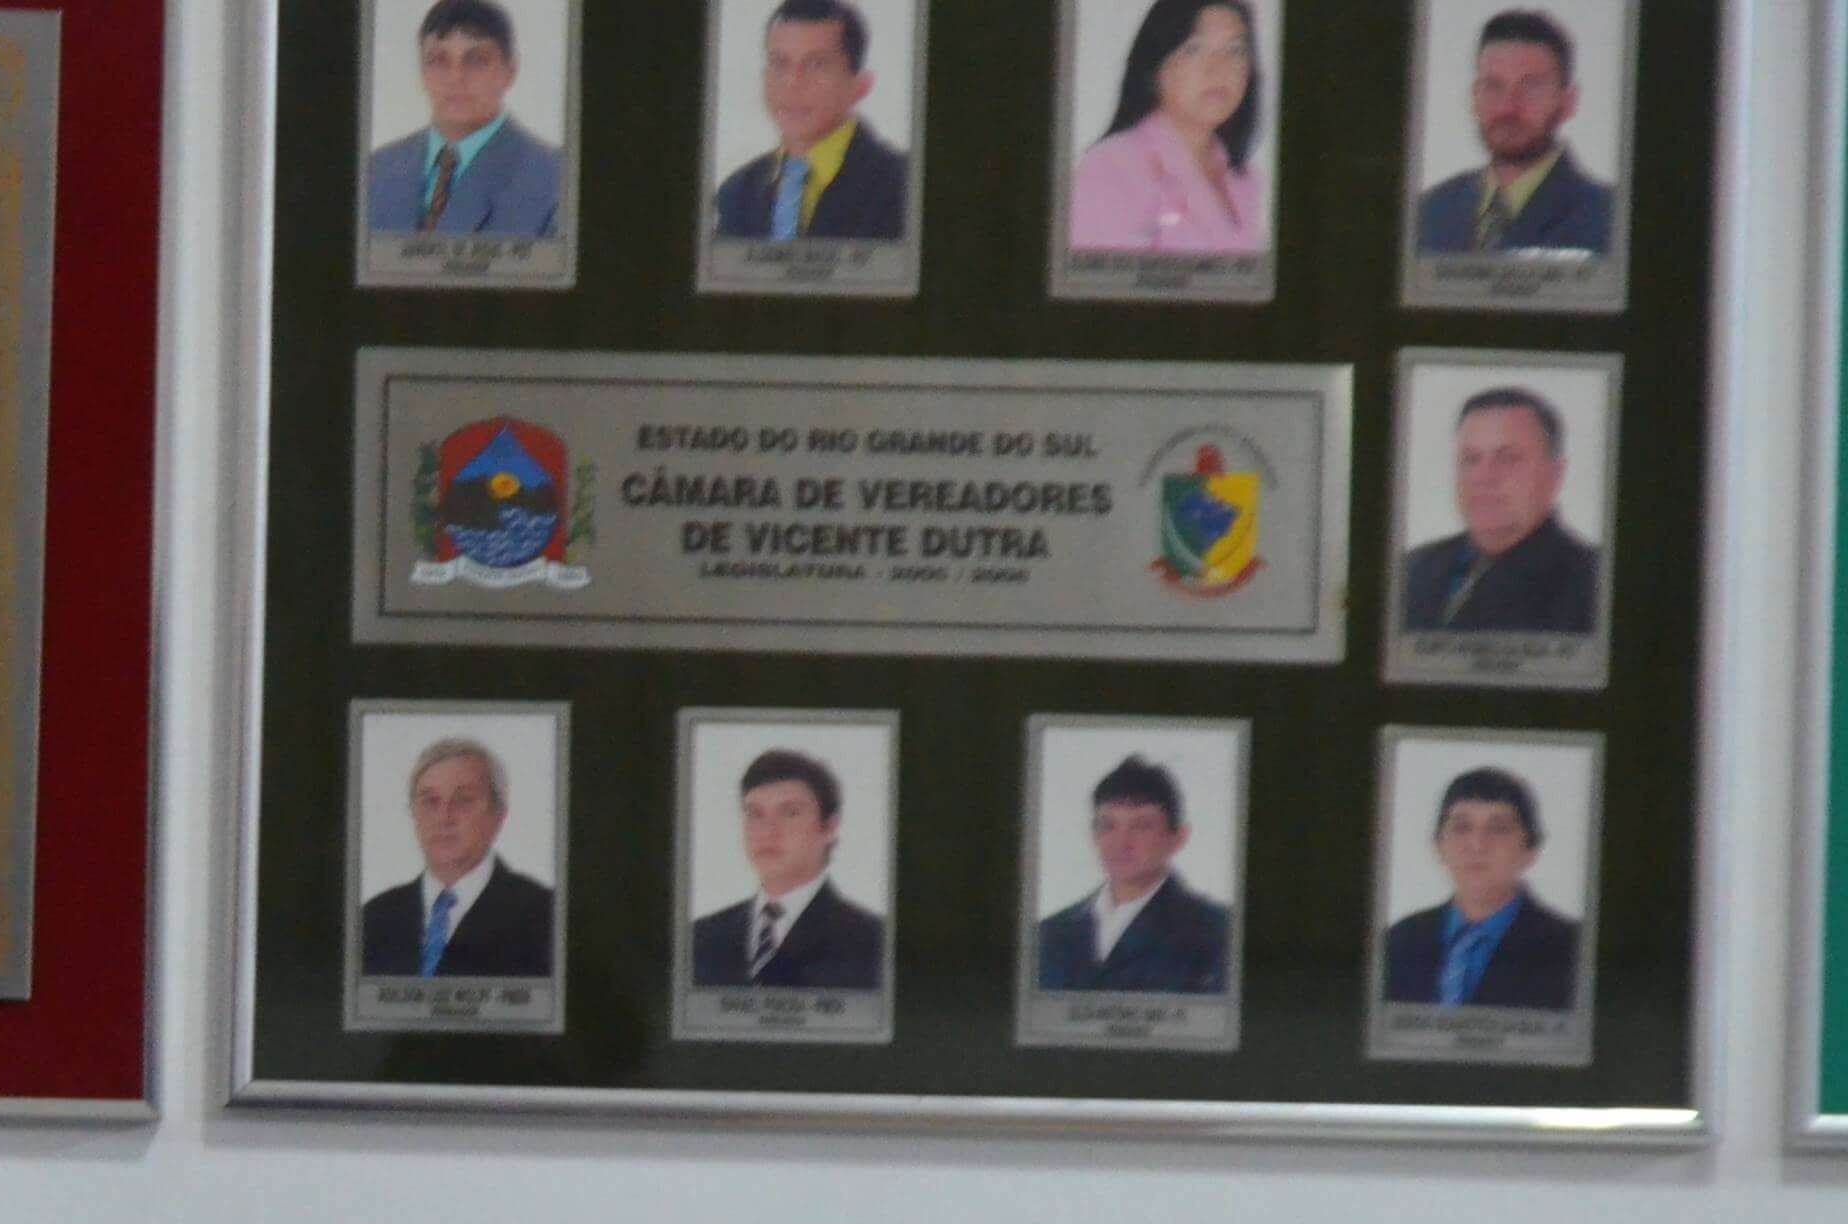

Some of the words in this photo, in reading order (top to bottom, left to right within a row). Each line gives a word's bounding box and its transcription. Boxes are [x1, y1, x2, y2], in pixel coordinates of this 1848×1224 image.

[634, 423, 751, 455] ESTADO
[757, 426, 800, 455] DO
[806, 427, 859, 456] RIO
[865, 429, 984, 457] GRANDE
[992, 432, 1035, 458] DO
[1043, 433, 1097, 459] SUL
[619, 464, 783, 510] CÂMARA
[793, 476, 844, 511] DE
[858, 479, 1113, 516] VEREADORES
[680, 520, 733, 556] DE
[744, 522, 908, 558] VICENTE
[920, 526, 1052, 559] DUTRA
[697, 560, 866, 581] LEGISLATURA
